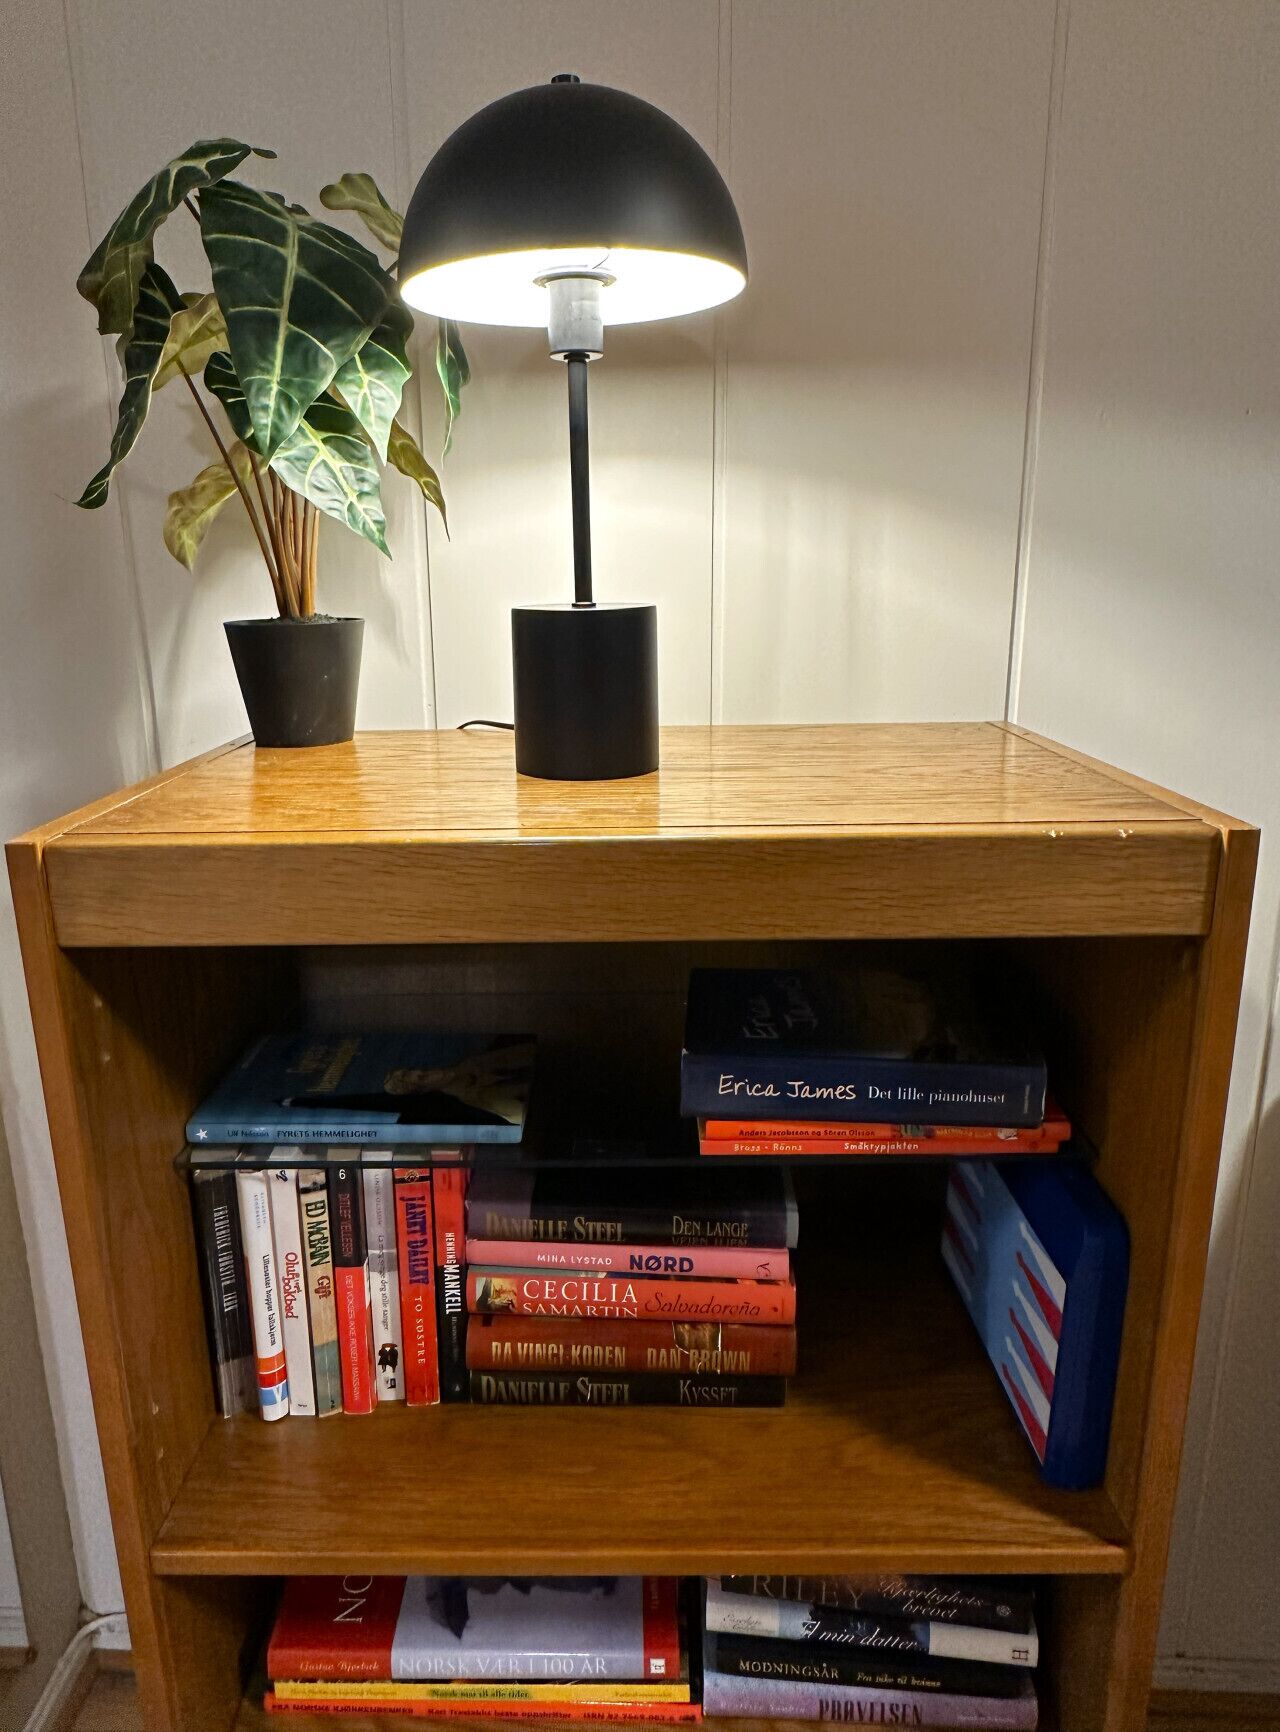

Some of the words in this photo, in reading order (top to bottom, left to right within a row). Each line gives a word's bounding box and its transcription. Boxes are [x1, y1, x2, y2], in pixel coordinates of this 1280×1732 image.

[718, 1074, 783, 1097] Erica
[786, 1081, 857, 1101] James
[868, 1086, 892, 1100] Det
[897, 1087, 924, 1101] lille
[929, 1089, 1006, 1105] pianohuset
[843, 1141, 919, 1154] Småkrypjakten
[304, 1199, 328, 1219] ED
[400, 1194, 428, 1237] JANET
[486, 1212, 569, 1240] DANIELLE
[573, 1216, 625, 1242] STEEL
[672, 1215, 701, 1236] DEN
[706, 1221, 749, 1238] LANGE
[445, 1231, 457, 1264] HENNING
[537, 1253, 566, 1264] MINA
[571, 1255, 613, 1266] LYSTAD
[629, 1254, 694, 1273] NØRD
[281, 1276, 299, 1320] bokbad
[443, 1264, 462, 1315] MANKELL
[522, 1279, 639, 1304] CECILIA
[414, 1295, 424, 1312] TO
[522, 1302, 639, 1320] SAMARTIN
[644, 1291, 761, 1318] Salvadoreña
[414, 1317, 427, 1365] SØSTRE
[491, 1341, 513, 1365] DA
[647, 1347, 681, 1370] DAN
[688, 1349, 752, 1373] BROWN
[480, 1375, 570, 1405] DANIELLE
[575, 1376, 630, 1405] STEEL
[680, 1378, 738, 1405] KYSSET
[902, 1599, 958, 1620] brevet
[818, 1628, 855, 1643] min
[399, 1658, 470, 1674] NORSK
[476, 1658, 521, 1674] VÆR
[543, 1658, 575, 1675] 100
[581, 1656, 608, 1674] ÅR
[739, 1659, 840, 1680] MODNINGSÅR
